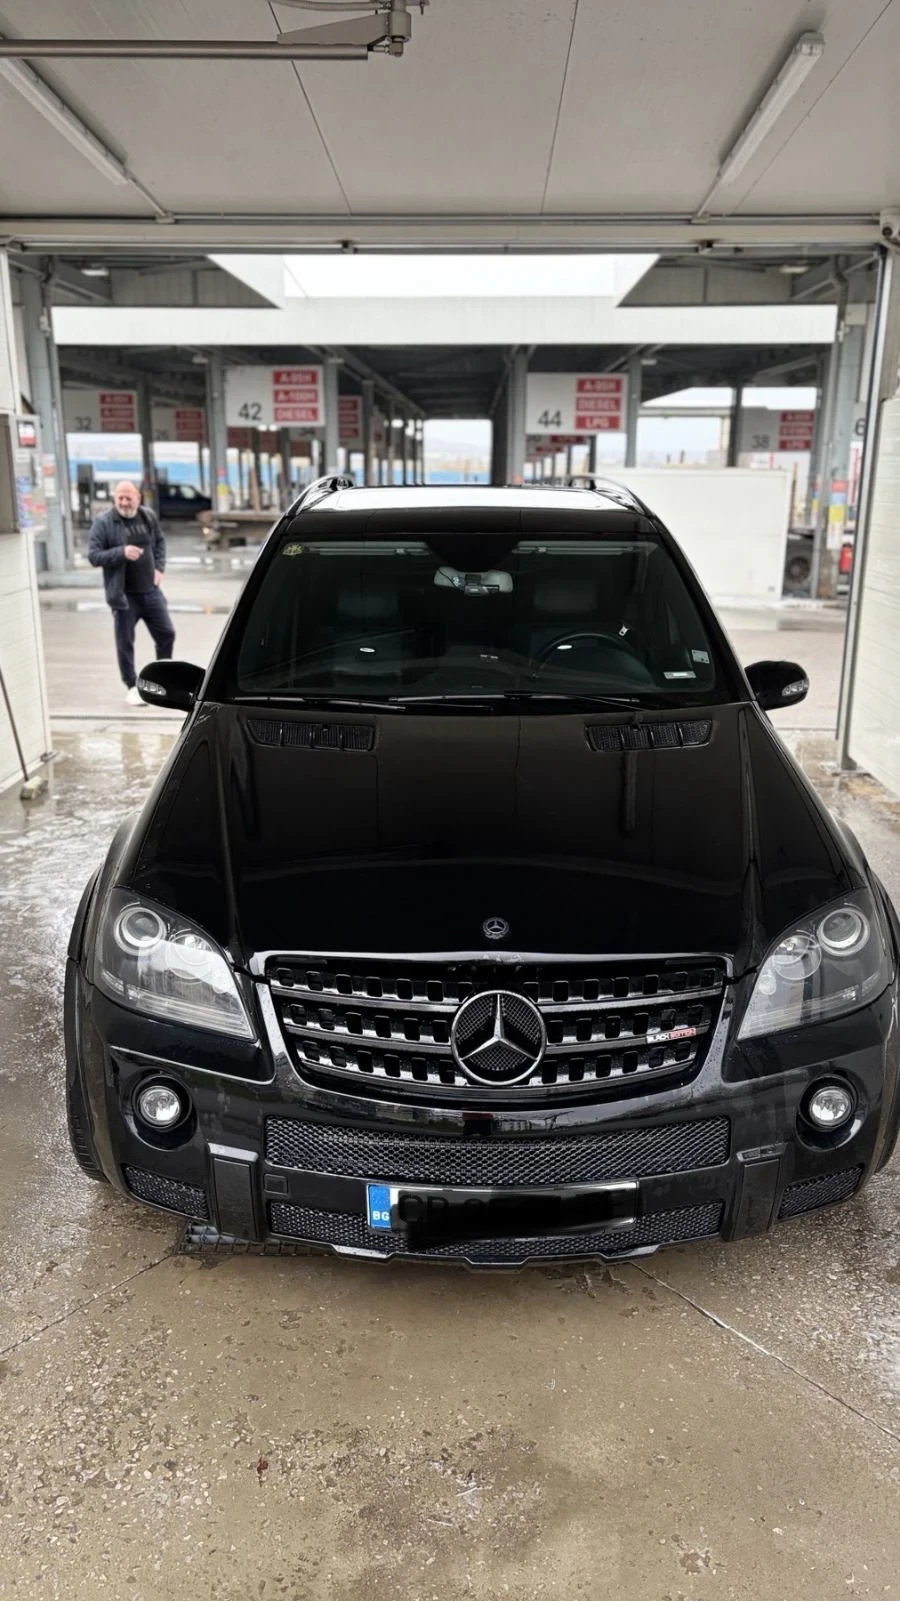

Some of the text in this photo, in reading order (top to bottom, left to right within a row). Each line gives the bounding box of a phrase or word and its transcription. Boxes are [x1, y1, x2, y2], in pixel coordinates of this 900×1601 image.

[578, 398, 618, 410] DIESEL
[238, 401, 263, 421] 42
[275, 409, 316, 420] DIESEL
[74, 416, 92, 431] 32
[537, 409, 562, 428] 44
[585, 417, 610, 428] LPG
[752, 434, 769, 449] 38
[373, 1210, 390, 1221] BG
